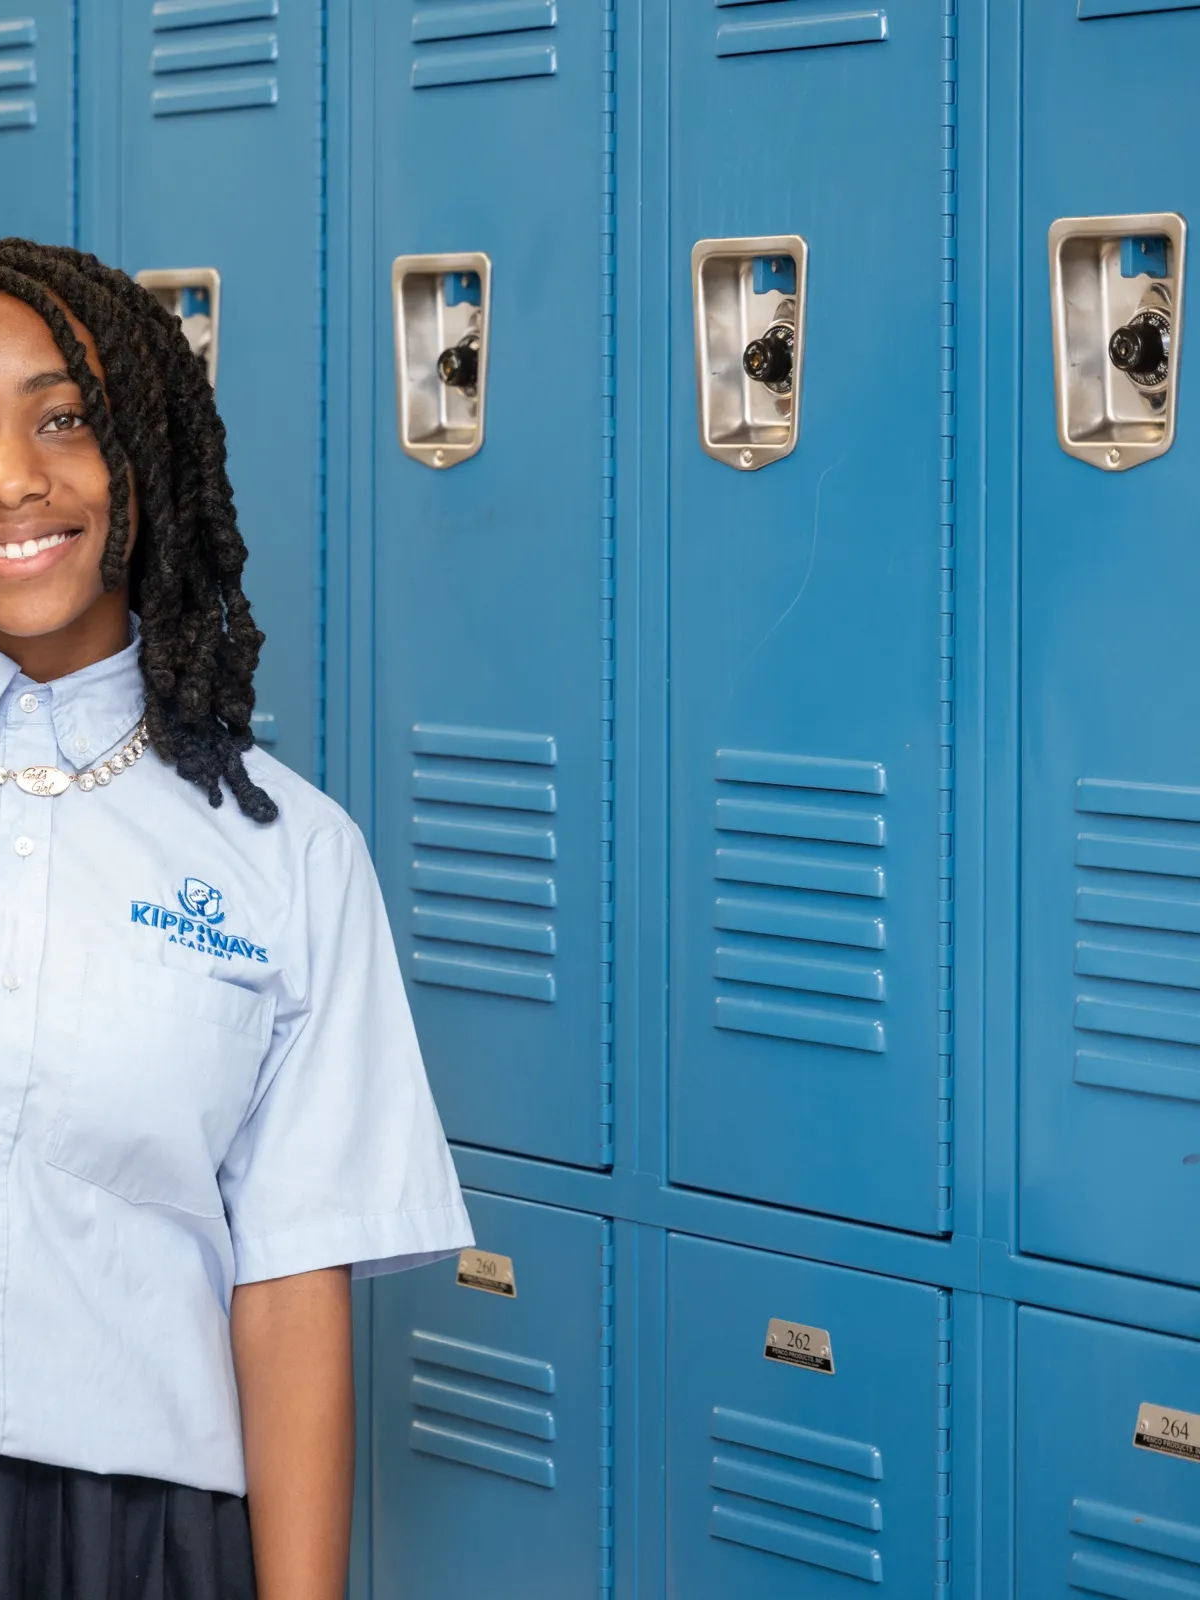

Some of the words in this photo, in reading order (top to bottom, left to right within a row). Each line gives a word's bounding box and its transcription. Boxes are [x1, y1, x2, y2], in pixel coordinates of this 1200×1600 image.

[1148, 317, 1160, 327] 20
[22, 767, 47, 780] God's
[31, 780, 55, 794] Girl
[168, 934, 233, 961] ACADEMY
[476, 1257, 498, 1277] 260
[787, 1330, 811, 1351] 262
[1161, 1416, 1190, 1441] 264
[1143, 1434, 1162, 1445] PENCO
